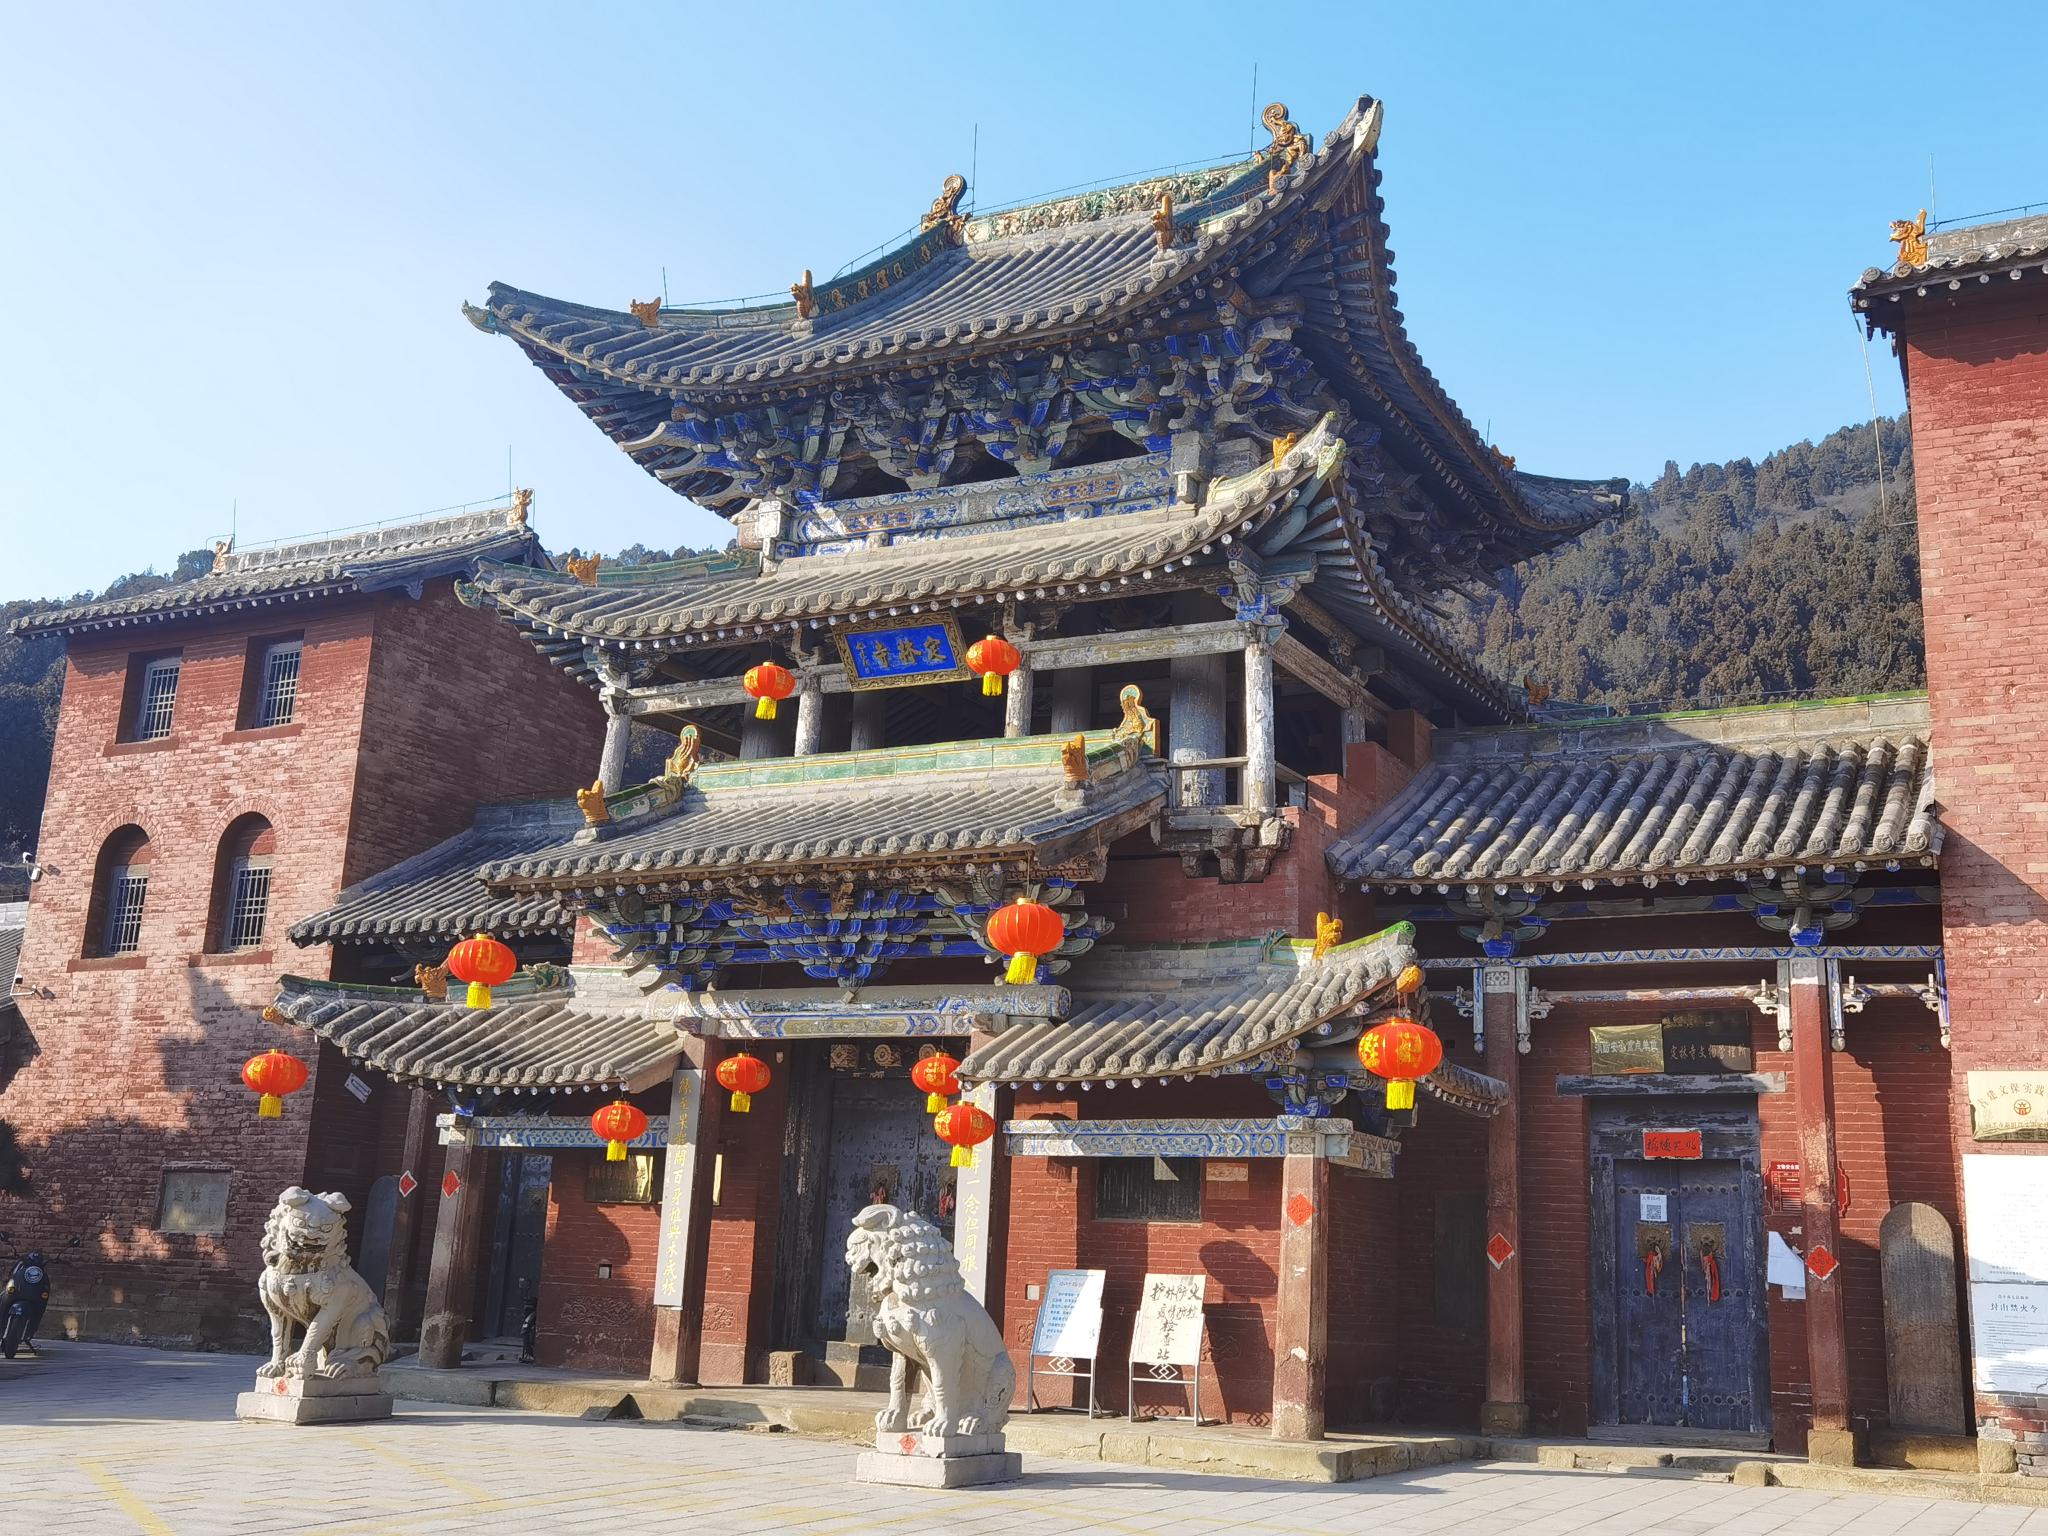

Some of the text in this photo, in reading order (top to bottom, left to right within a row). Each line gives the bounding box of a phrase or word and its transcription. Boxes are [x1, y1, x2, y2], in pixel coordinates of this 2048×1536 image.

[1150, 1282, 1202, 1301] 护林防火
[1991, 1302, 2038, 1313] 封山禁火令
[1157, 1319, 1178, 1360] 检查站
